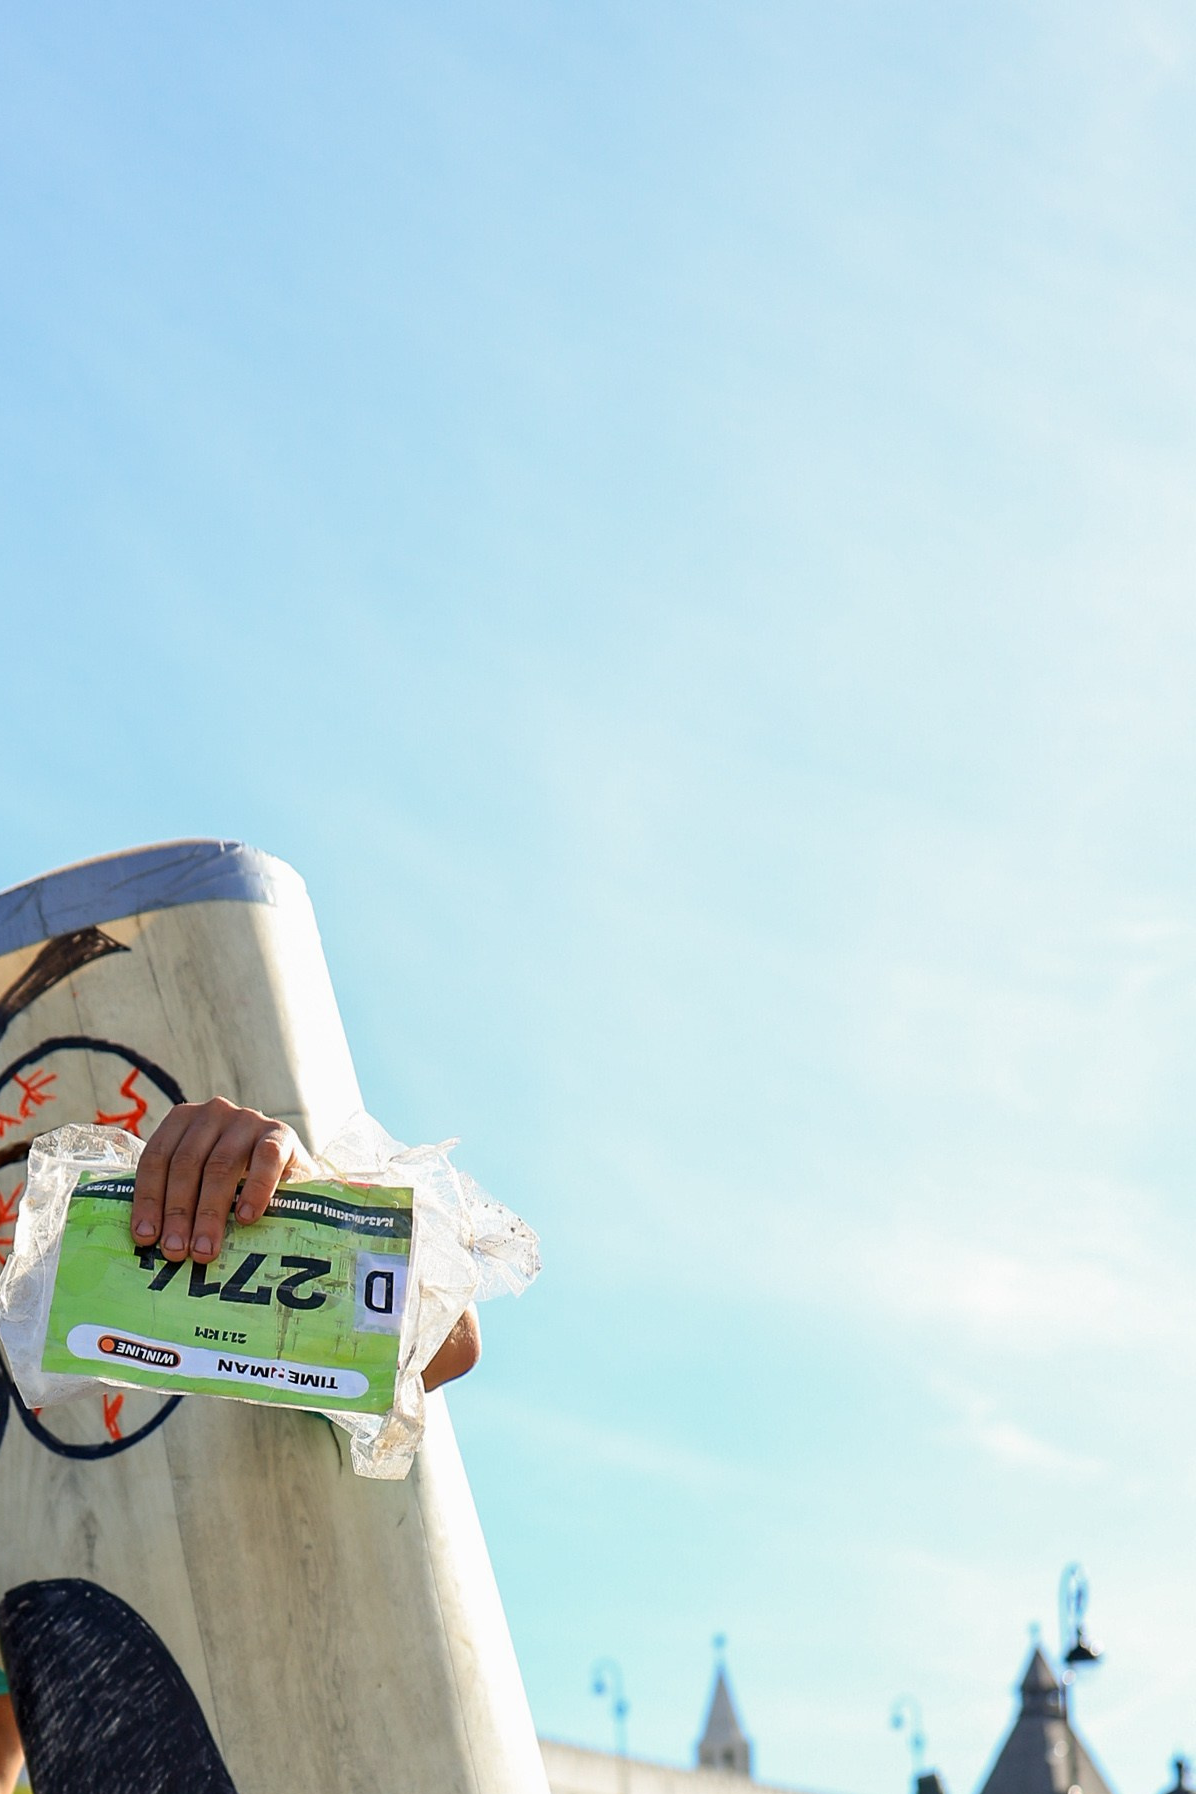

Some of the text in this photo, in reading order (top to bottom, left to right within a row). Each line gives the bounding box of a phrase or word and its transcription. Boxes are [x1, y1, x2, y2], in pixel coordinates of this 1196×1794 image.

[133, 1245, 332, 1311] 2714
[363, 1270, 394, 1314] D
[114, 1341, 176, 1365] WINLINE
[221, 1330, 247, 1345] 21.1
